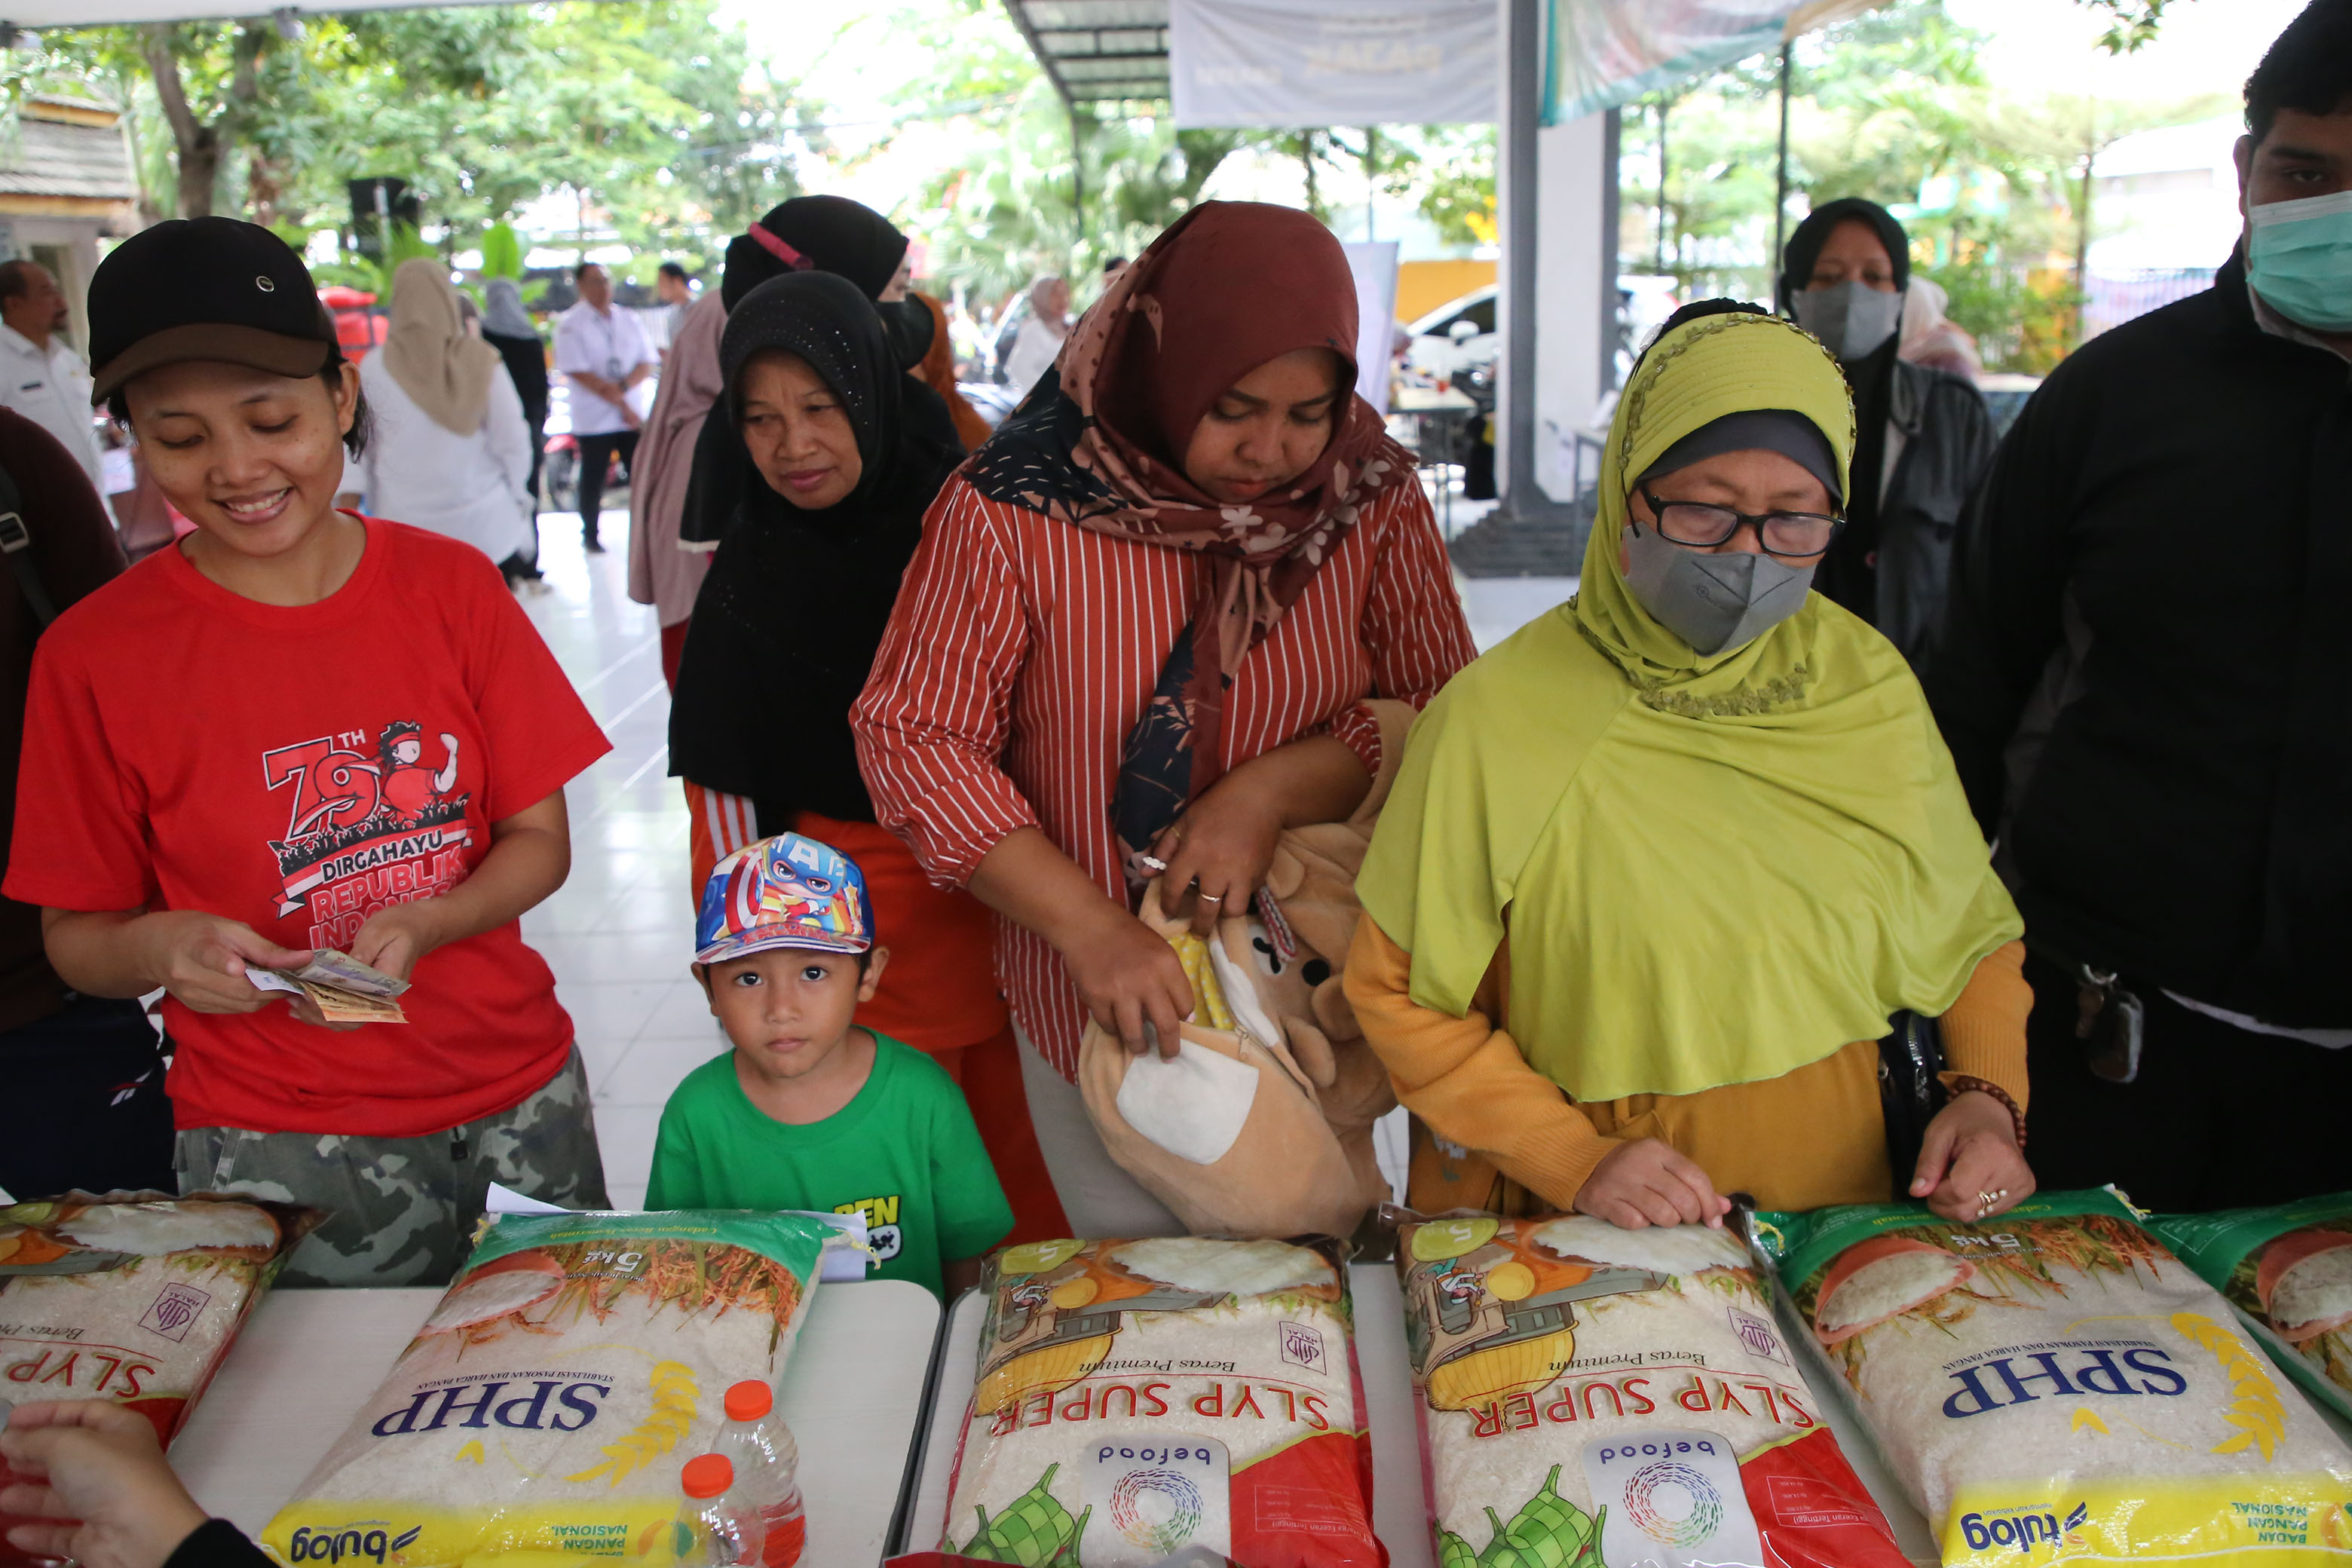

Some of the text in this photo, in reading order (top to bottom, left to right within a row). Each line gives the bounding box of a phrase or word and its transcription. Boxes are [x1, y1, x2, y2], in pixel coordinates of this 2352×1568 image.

[320, 830, 443, 884] DIRGAHAYU
[311, 846, 466, 923] REPUBLIK
[1448, 1223, 1472, 1243] 5
[1950, 1233, 2020, 1248] 5 kg
[581, 1250, 643, 1272] 5 kg
[169, 1291, 201, 1307] HALAL
[28, 1324, 85, 1340] Beras
[1286, 1329, 1318, 1343] HALAL
[1548, 1350, 1705, 1373] Beras Premium
[1941, 1340, 2154, 1371] STABILISASI PASOKAN DAN HARGA PANGAN
[7, 1351, 156, 1398] SLYP
[1079, 1359, 1236, 1374] Beras Premium
[416, 1370, 615, 1391] STABILISASI PASOKAN DAN HARGA PANGAN
[1942, 1349, 2187, 1419] SPHP
[371, 1380, 611, 1438] SPHP
[991, 1383, 1330, 1438] SLYP SUPER
[1466, 1376, 1815, 1438] SLYP SUPER
[1098, 1446, 1210, 1465] befood
[1600, 1441, 1715, 1464] befood
[1793, 1514, 1857, 1524] Eceran Tertinggi)
[2231, 1502, 2308, 1516] NASIONAL
[551, 1524, 628, 1537] NASIONAL
[2248, 1517, 2308, 1530] PANGAN
[290, 1527, 387, 1565] bulog
[563, 1537, 626, 1550] PANGAN
[2258, 1532, 2307, 1544] BADAN
